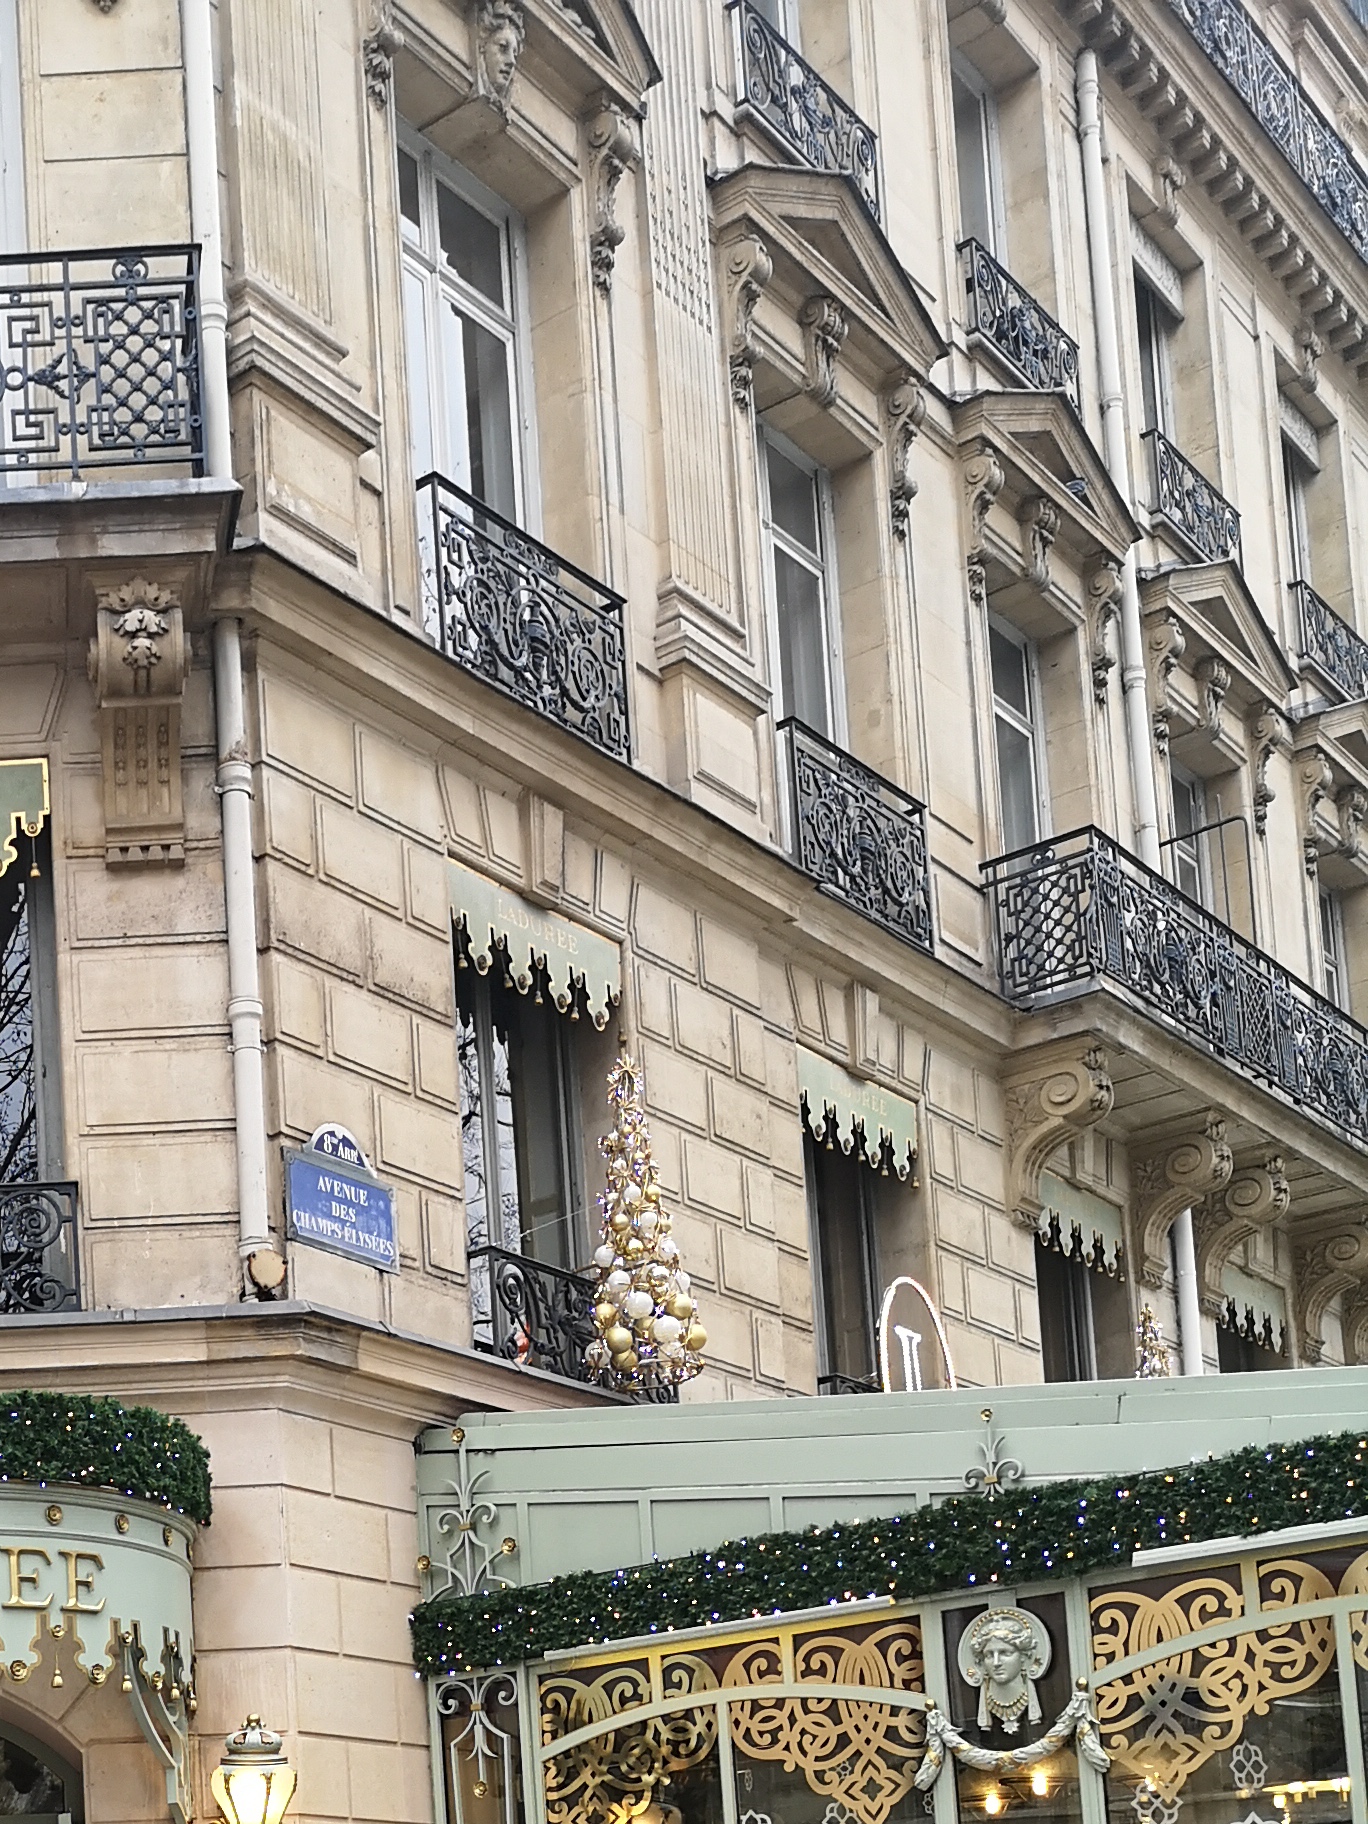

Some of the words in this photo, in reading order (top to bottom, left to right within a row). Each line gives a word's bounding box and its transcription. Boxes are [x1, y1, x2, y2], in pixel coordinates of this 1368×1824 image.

[497, 898, 579, 955] LADUREE
[317, 1174, 369, 1207] AVENUE
[331, 1201, 357, 1223] DES
